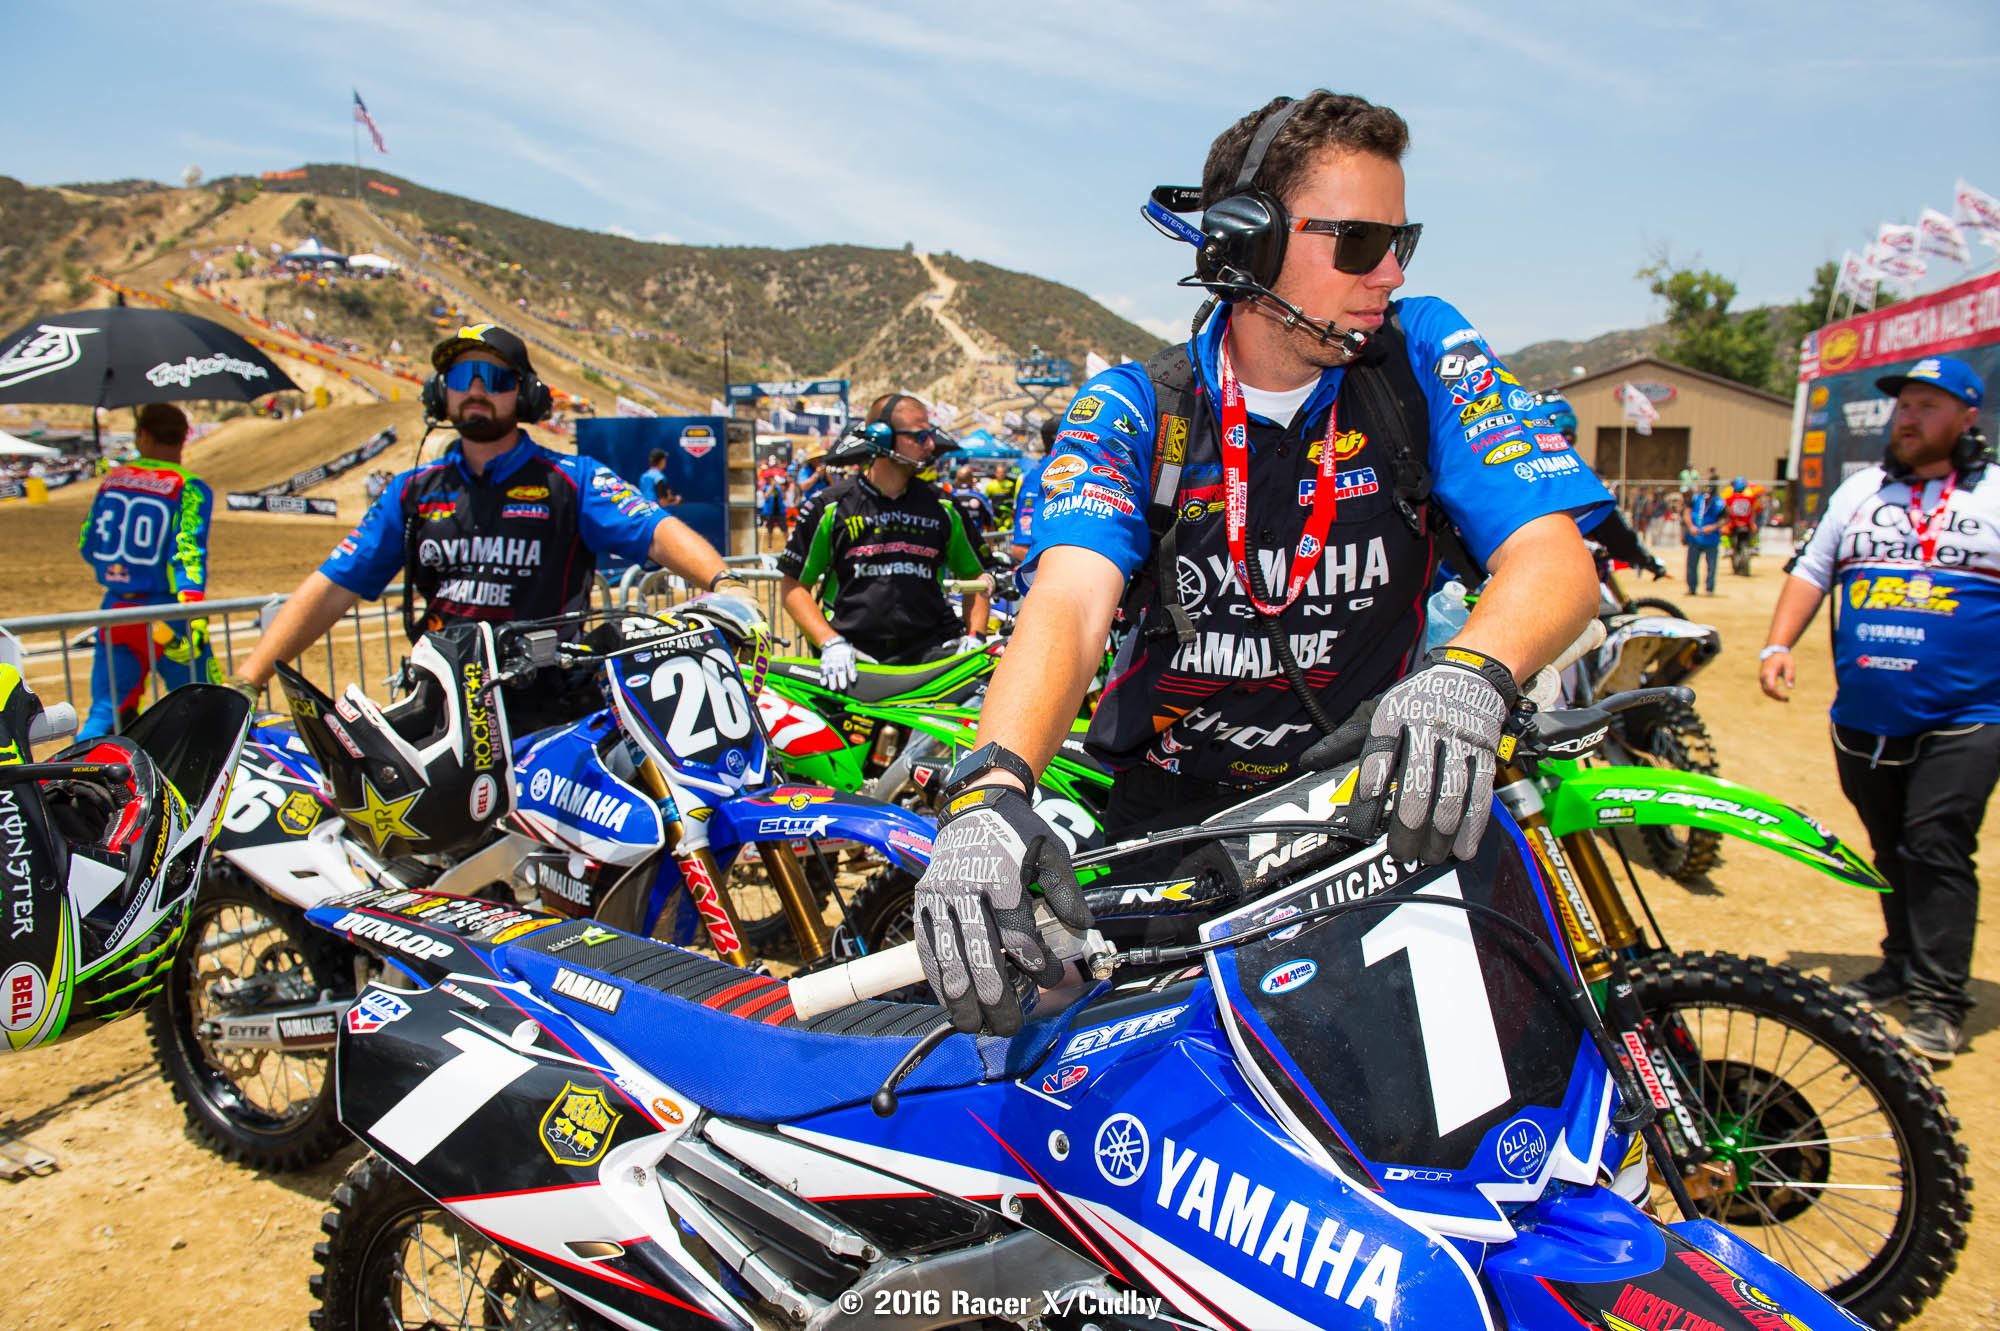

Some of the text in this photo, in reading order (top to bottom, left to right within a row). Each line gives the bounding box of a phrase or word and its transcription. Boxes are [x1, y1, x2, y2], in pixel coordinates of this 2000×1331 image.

[1160, 212, 1201, 242] STERLING
[1466, 414, 1515, 440] EXCEL
[1489, 441, 1529, 464] ARC
[1528, 454, 1580, 473] YAMAHA
[1101, 486, 1128, 502] TOYOTA
[1299, 482, 1379, 506] UMITED
[1300, 467, 1377, 496] PRTS
[1056, 494, 1115, 518] YAMAHA
[1082, 488, 1135, 516] ESCONDIDO
[1871, 502, 1980, 536] Cyle
[92, 490, 170, 567] 30
[441, 535, 542, 567] YAMAHA
[853, 560, 933, 580] Kawasaki
[1187, 597, 1375, 620] ACNG
[650, 648, 751, 758] 26
[1386, 696, 1487, 735] Mechanix
[222, 765, 288, 835] 6
[476, 782, 490, 815] BELL
[549, 774, 633, 833] YAMAHA
[1595, 787, 1783, 825] PRO CIRCUIT
[149, 816, 171, 878] CIRCUIT
[978, 813, 1014, 845] GRIP
[0, 789, 34, 940] MONSTER
[538, 861, 592, 907] YAMALUBE
[1309, 854, 1398, 923] LUCAS
[1537, 825, 1602, 944] PRO CIRCUIT
[333, 911, 455, 962] DUNLOP
[1268, 912, 1286, 924] LUCAS
[552, 967, 624, 1013] YAMAHA
[1268, 963, 1312, 992] AMA PRO
[10, 974, 34, 1026] BELL
[1360, 868, 1512, 1139] 1
[279, 1015, 337, 1039] YAMALUBE
[1060, 1005, 1186, 1060] GYTR
[1043, 1065, 1076, 1092] VP
[1624, 1033, 1668, 1107] BRAKING
[367, 1027, 539, 1167] 1
[1650, 1048, 1703, 1148] UNLOP
[1155, 1136, 1404, 1324] YAMAHA
[1612, 1283, 1685, 1331] MICKEY
